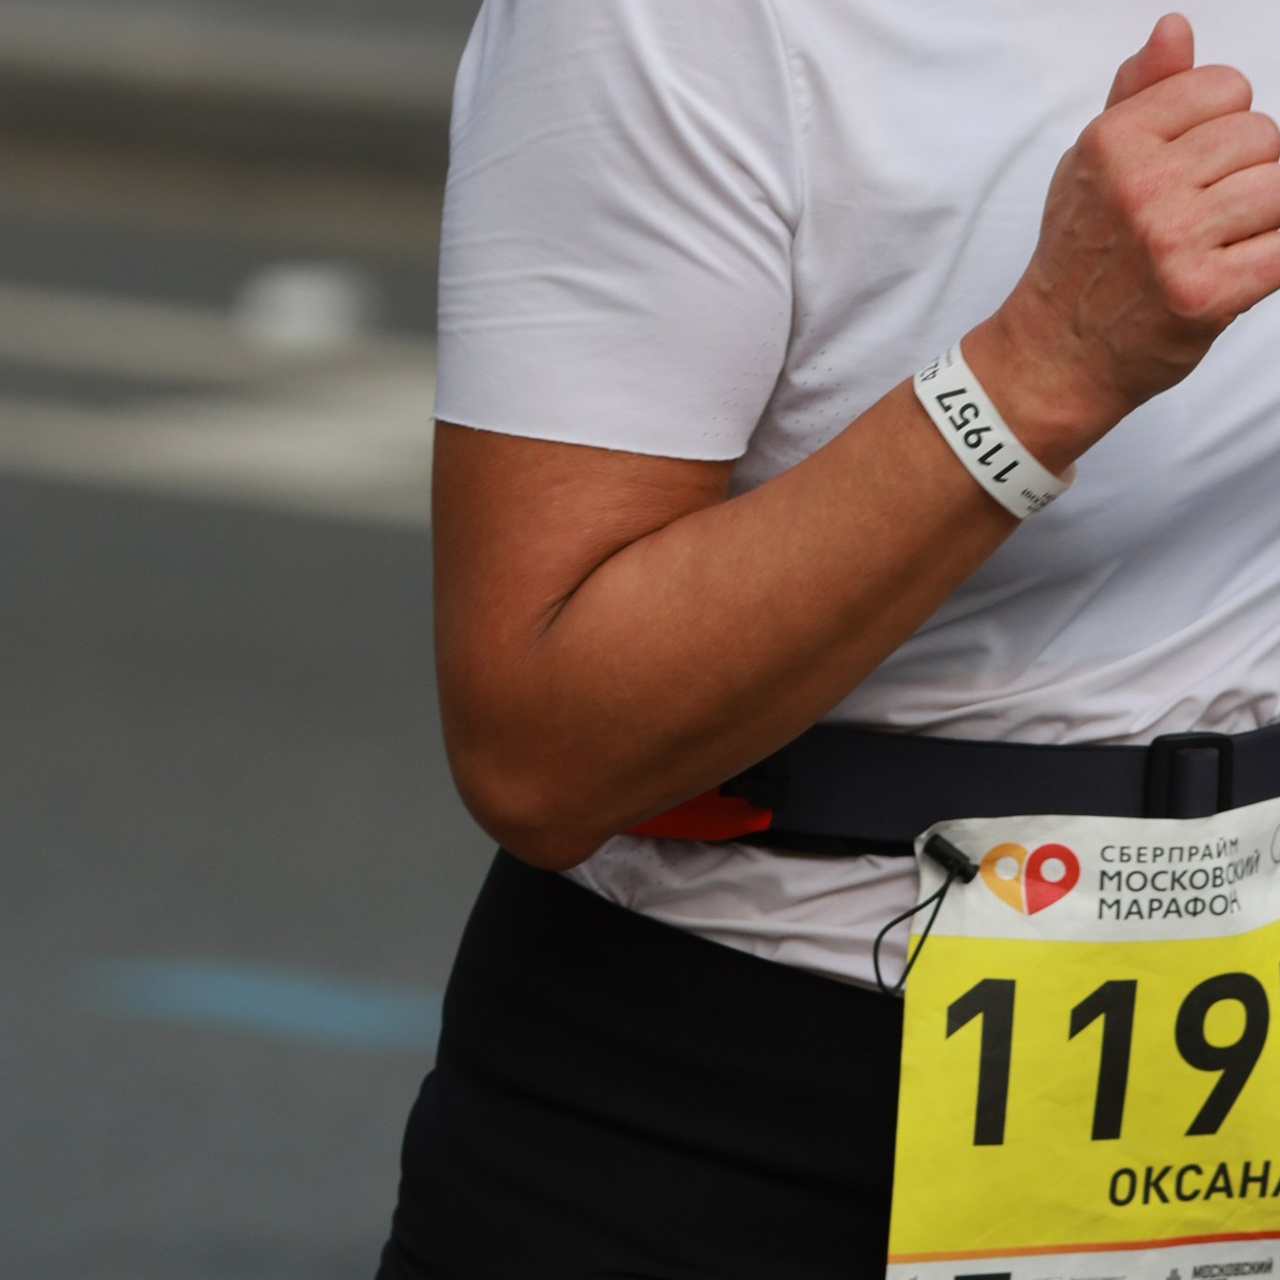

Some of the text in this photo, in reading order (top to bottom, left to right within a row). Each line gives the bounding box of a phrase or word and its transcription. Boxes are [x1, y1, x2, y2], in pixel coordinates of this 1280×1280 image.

[935, 387, 1020, 484] 11957
[1100, 837, 1239, 864] СБЕРПРАЙМ
[1098, 849, 1261, 892] МОСКОВСКИЙ
[1098, 890, 1241, 920] МАРАФОН
